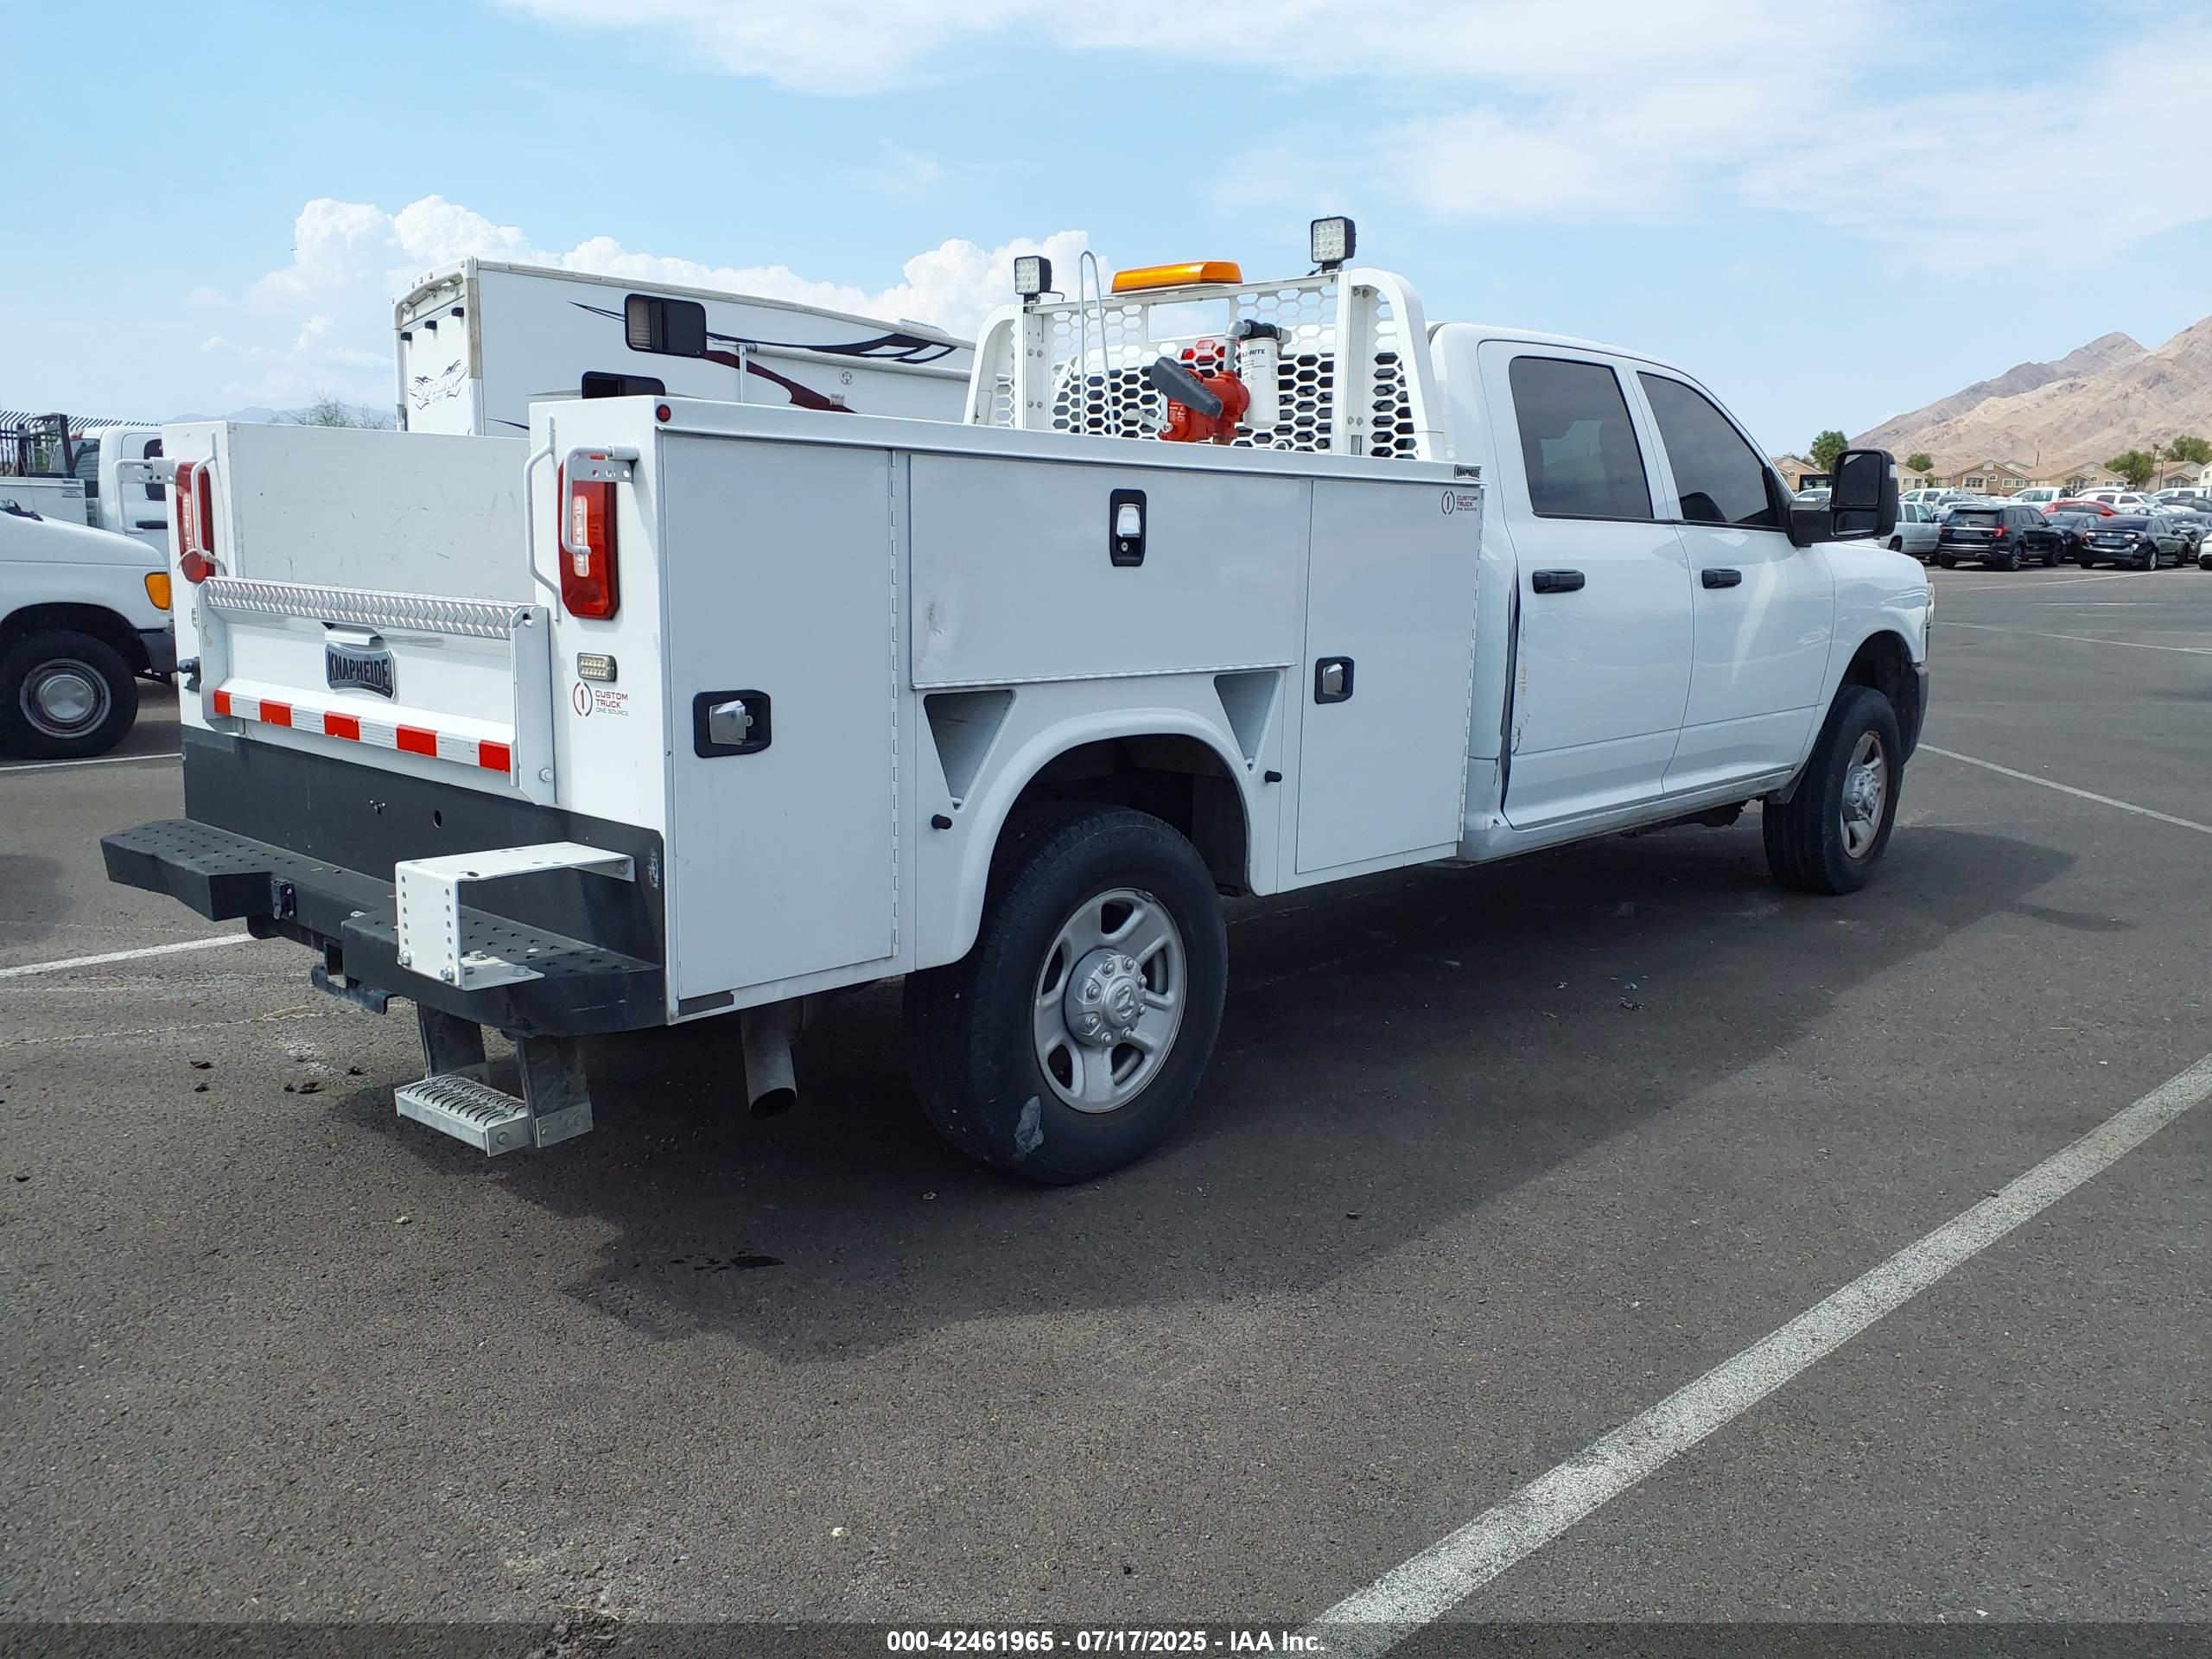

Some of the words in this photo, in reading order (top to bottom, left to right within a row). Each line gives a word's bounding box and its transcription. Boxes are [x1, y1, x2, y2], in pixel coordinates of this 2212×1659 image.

[327, 650, 389, 690] KNAPHEIDE
[594, 690, 629, 702] CUSTOM
[594, 698, 621, 709] TRUCK
